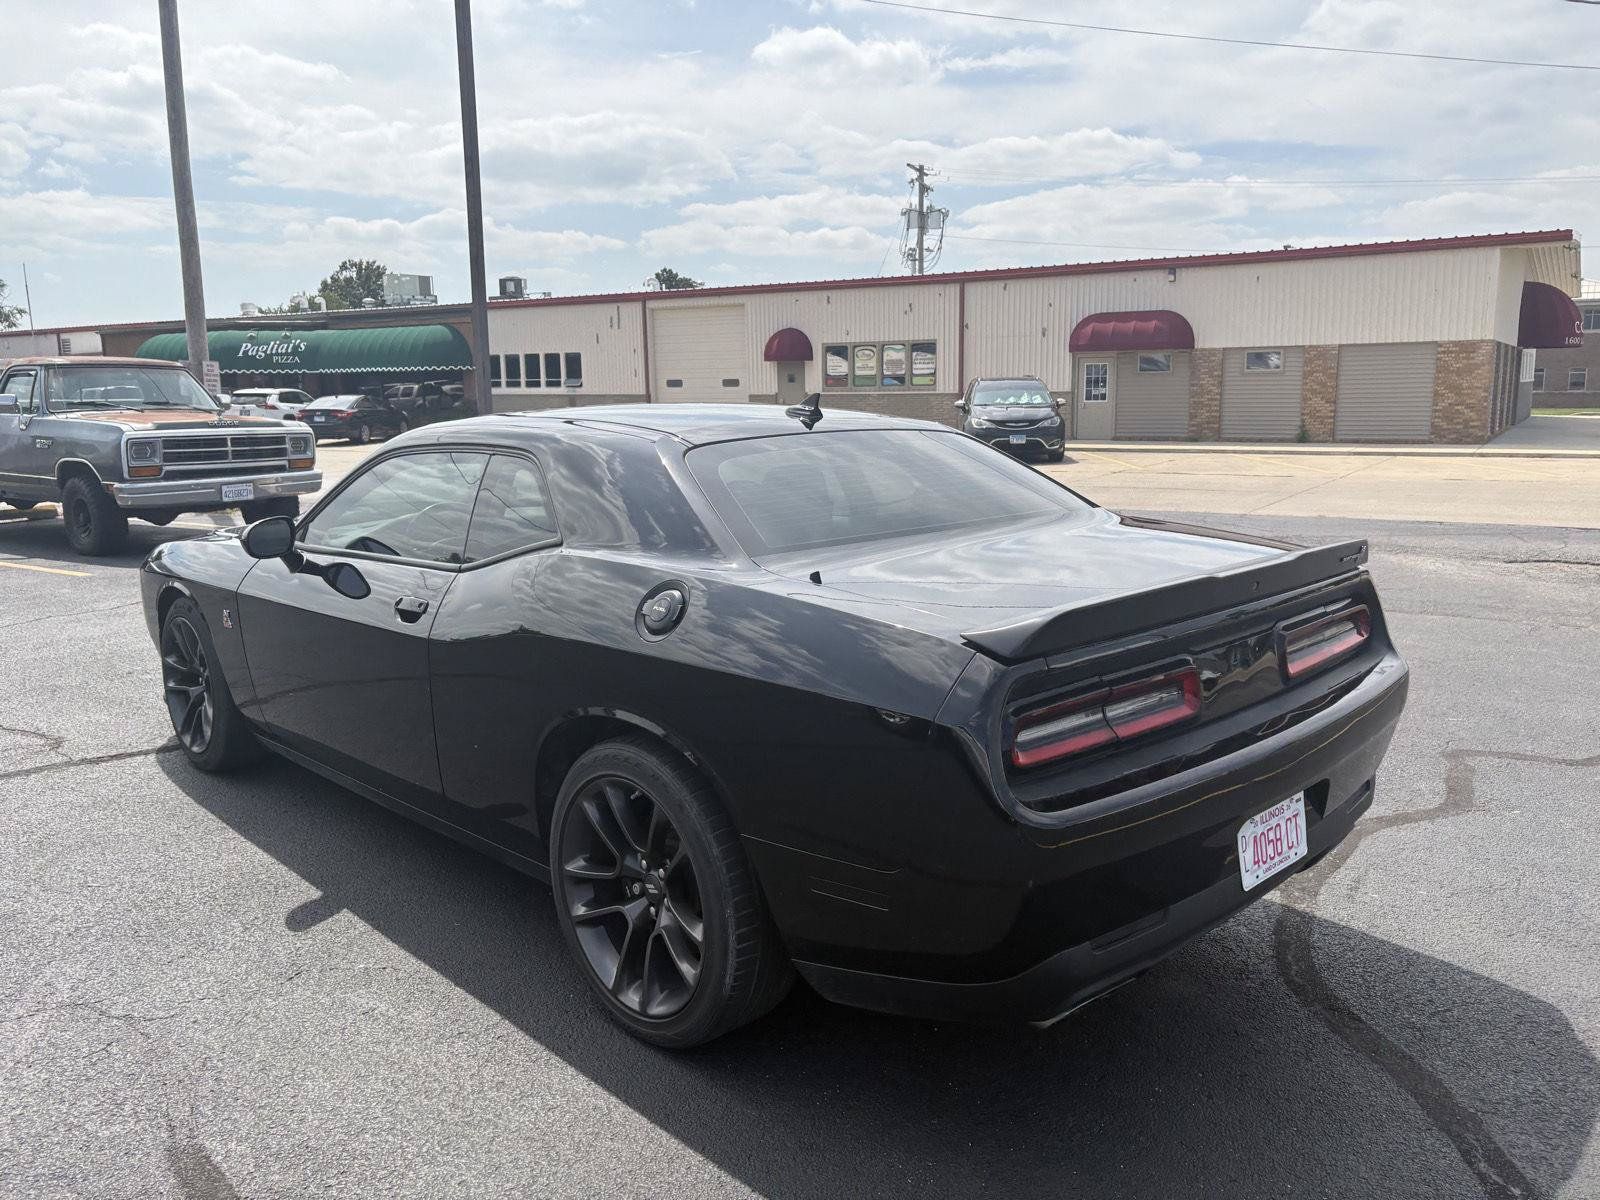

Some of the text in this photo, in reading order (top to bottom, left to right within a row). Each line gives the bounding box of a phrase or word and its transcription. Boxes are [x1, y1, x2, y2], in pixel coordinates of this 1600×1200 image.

[237, 339, 306, 360] Pagliai's
[1260, 804, 1284, 826] ILLINOIS
[1252, 812, 1299, 868] 4058 CT
